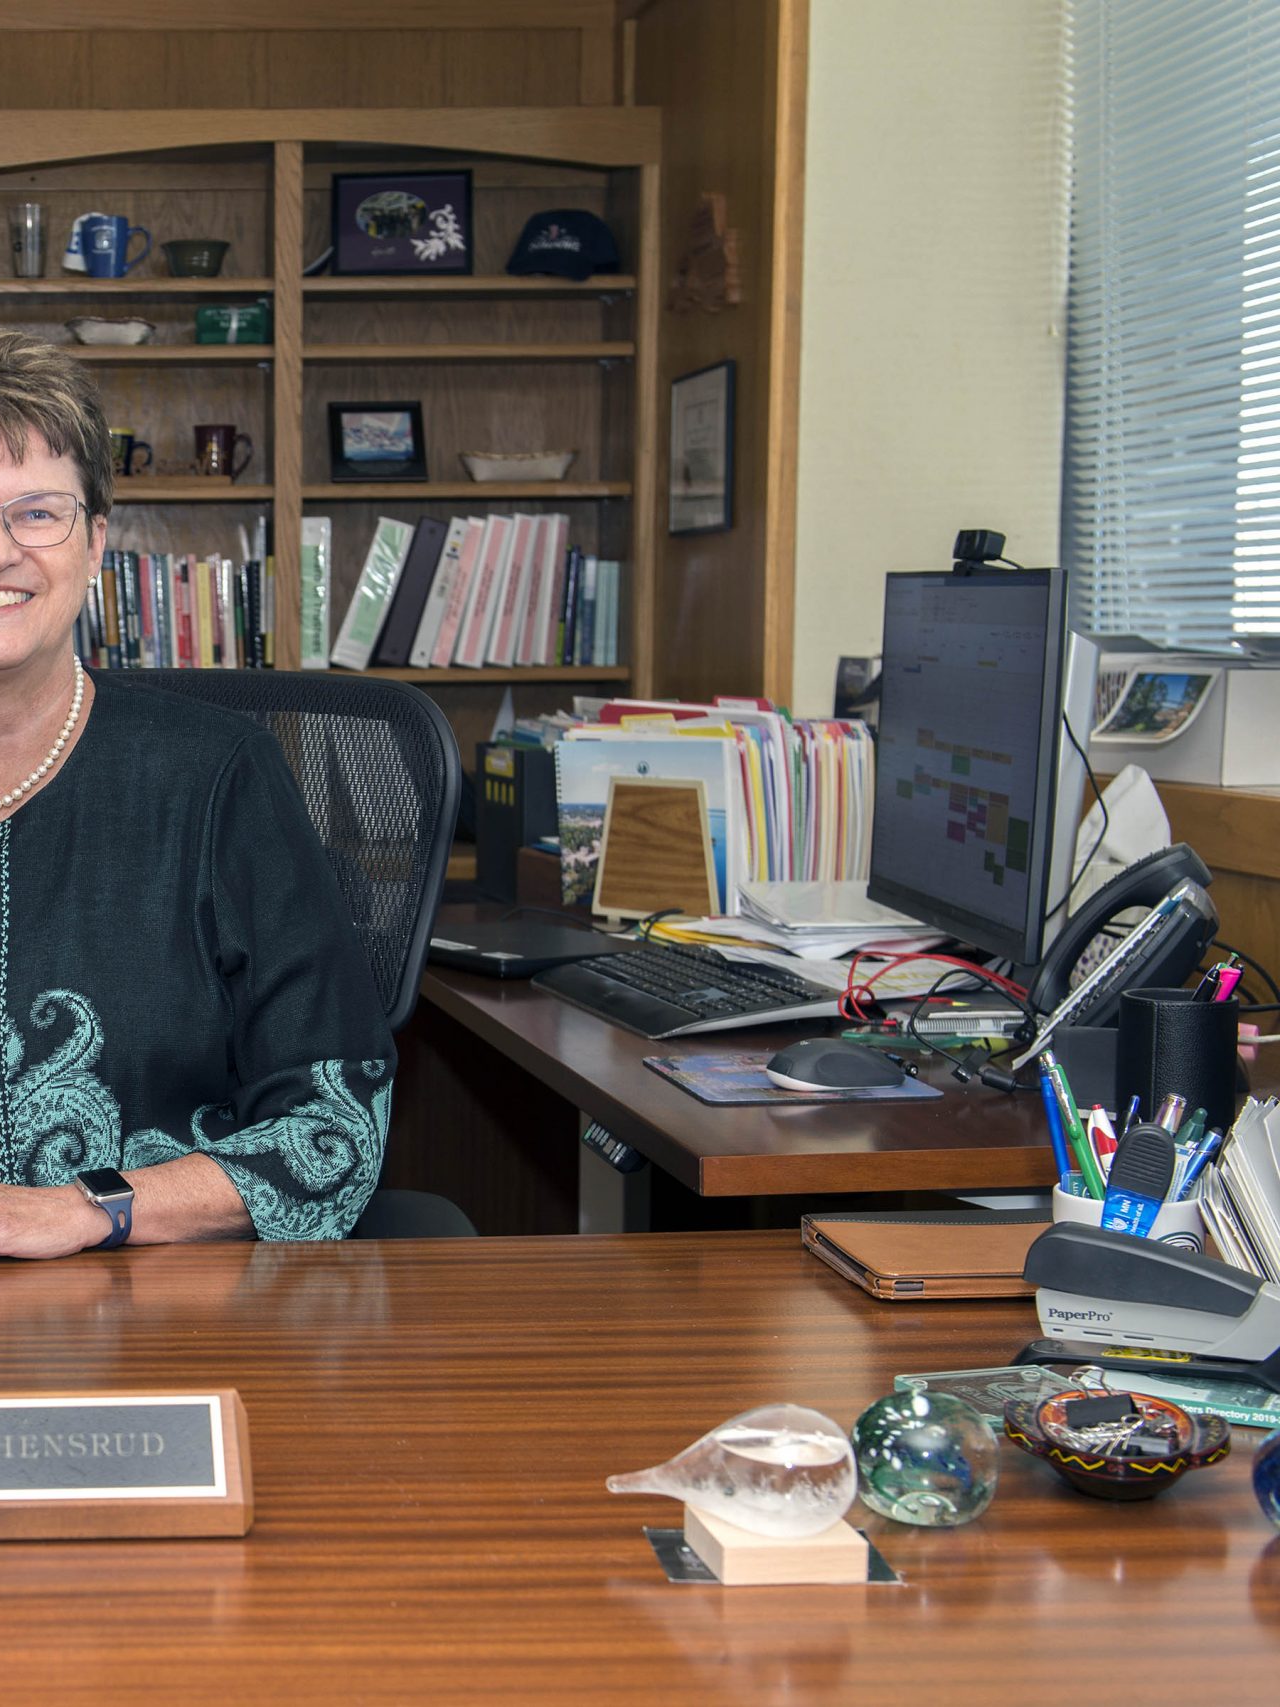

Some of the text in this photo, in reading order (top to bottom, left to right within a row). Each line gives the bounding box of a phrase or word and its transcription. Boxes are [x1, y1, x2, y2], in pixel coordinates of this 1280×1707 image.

[1120, 1199, 1132, 1214] MN
[1048, 1308, 1111, 1322] PaperPro
[1206, 1407, 1250, 1421] Directory
